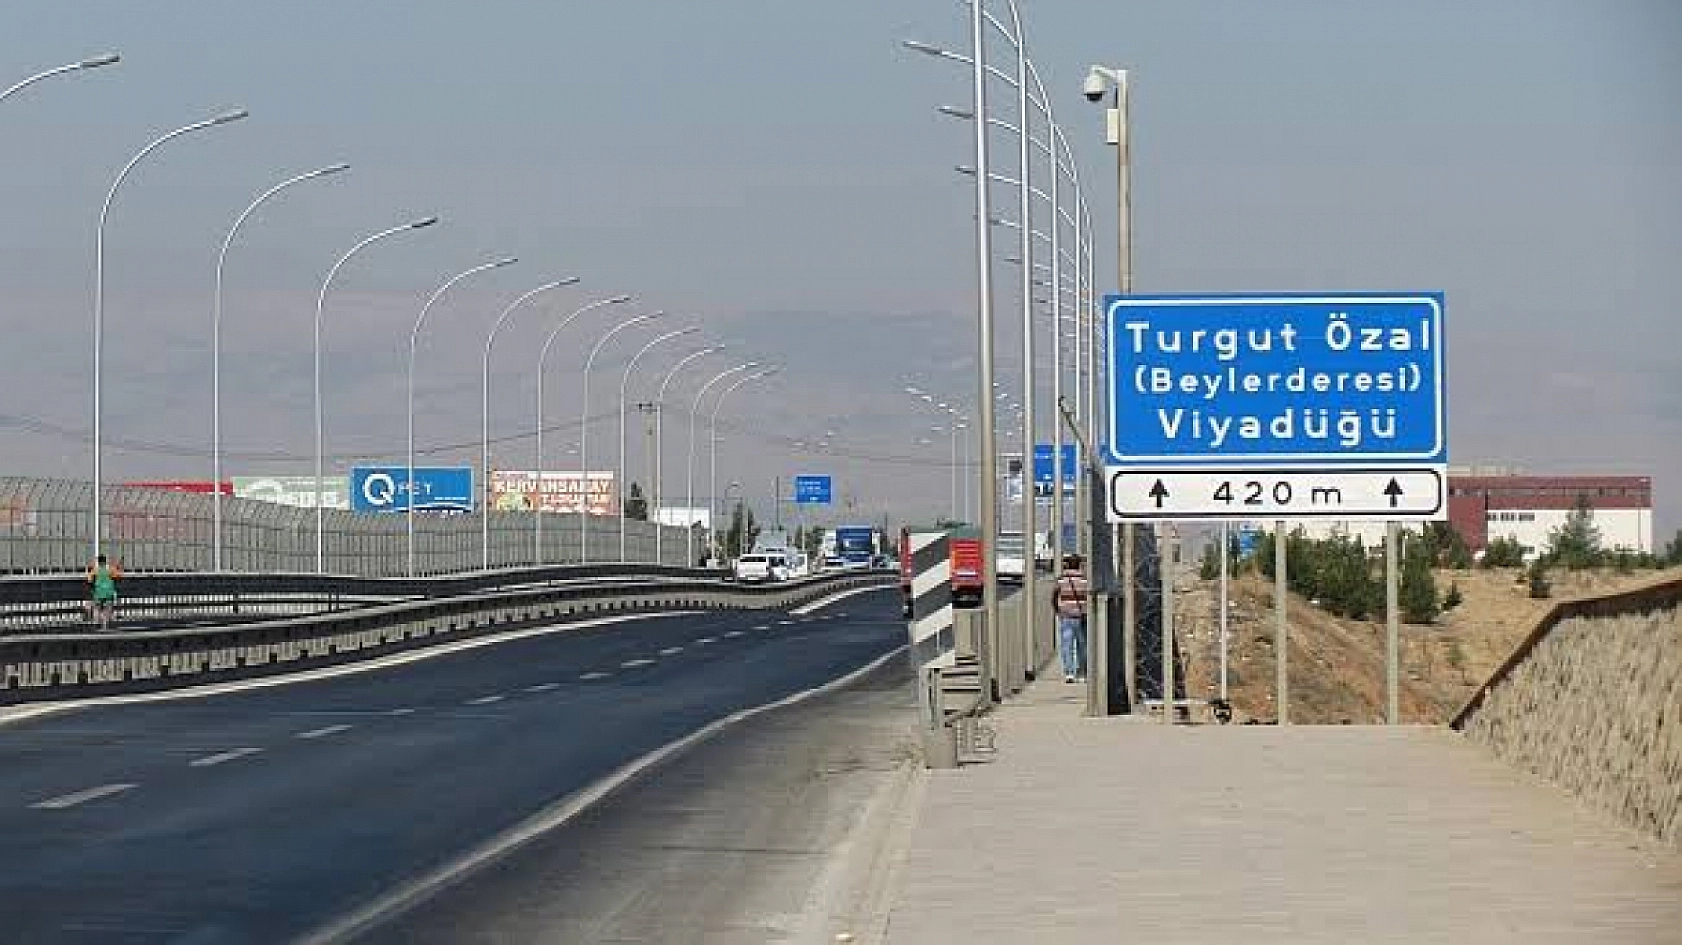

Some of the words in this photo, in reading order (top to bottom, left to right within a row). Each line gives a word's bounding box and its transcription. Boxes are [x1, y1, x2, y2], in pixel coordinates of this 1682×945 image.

[1125, 322, 1297, 361] Turgut
[1325, 313, 1429, 352] Özal
[1134, 362, 1421, 399] (Beylerderesi)
[1156, 409, 1396, 447] Viyadüğü
[1212, 481, 1293, 505] 420
[1311, 486, 1341, 504] m
